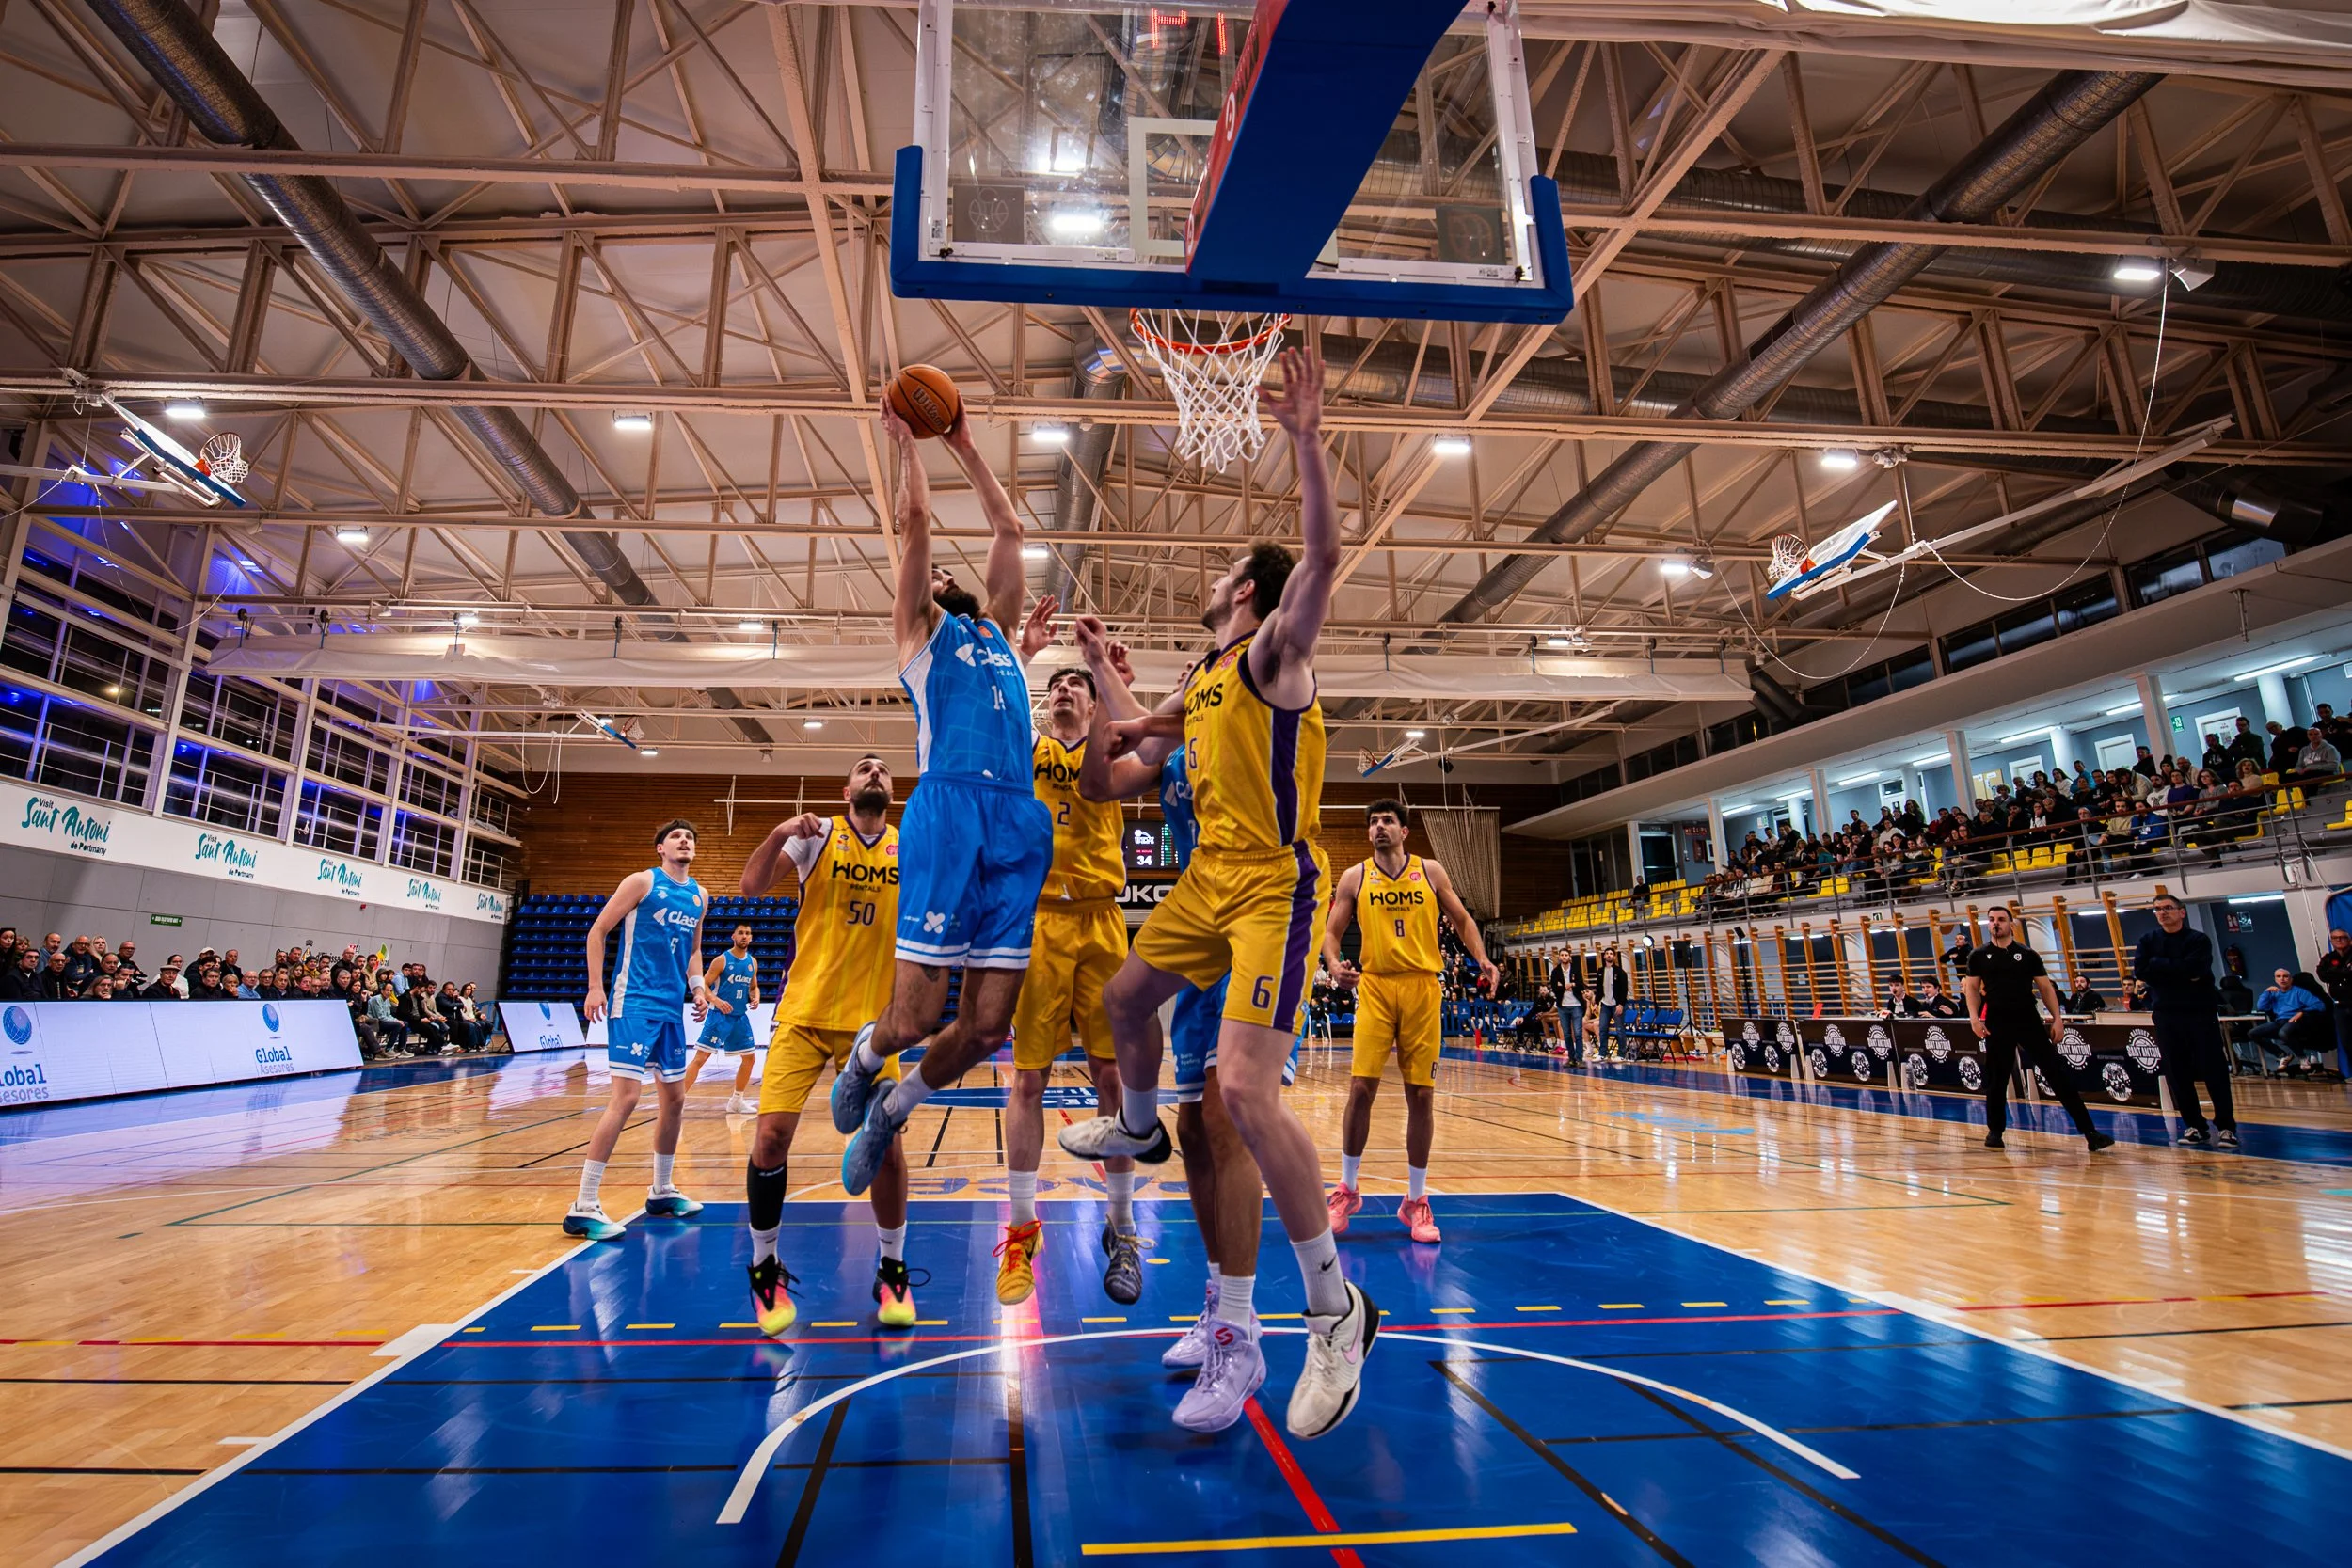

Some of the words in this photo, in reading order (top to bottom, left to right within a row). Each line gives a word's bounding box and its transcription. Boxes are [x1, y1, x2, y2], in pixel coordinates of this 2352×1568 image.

[913, 387, 946, 429] Wilson
[1185, 683, 1223, 715] OMS
[1189, 737, 1198, 769] 6
[1034, 761, 1081, 783] HOM
[40, 798, 55, 809] Visit
[1057, 801, 1071, 826] 2
[21, 797, 60, 833] Sant
[61, 806, 111, 843] Antoni
[207, 834, 217, 843] Visit
[70, 841, 78, 850] de
[78, 842, 107, 857] Portmany
[195, 833, 222, 863] Sant
[222, 839, 258, 869] Antoni
[1136, 855, 1153, 866] 34
[317, 858, 337, 882] Sant
[337, 863, 363, 888] Antoni
[832, 860, 899, 885] HOMS
[1369, 890, 1425, 906] HOMS
[847, 900, 876, 926] 50
[1394, 919, 1405, 937] 8
[735, 989, 743, 1000] 10
[1251, 975, 1275, 1010] 6
[255, 1045, 293, 1064] Global
[2057, 1043, 2071, 1054] SANT
[2071, 1044, 2092, 1056] ANTONI
[2126, 1045, 2141, 1057] SANT
[0, 1064, 47, 1087] obal
[260, 1063, 294, 1075] Asesores
[0, 1087, 49, 1103] esores
